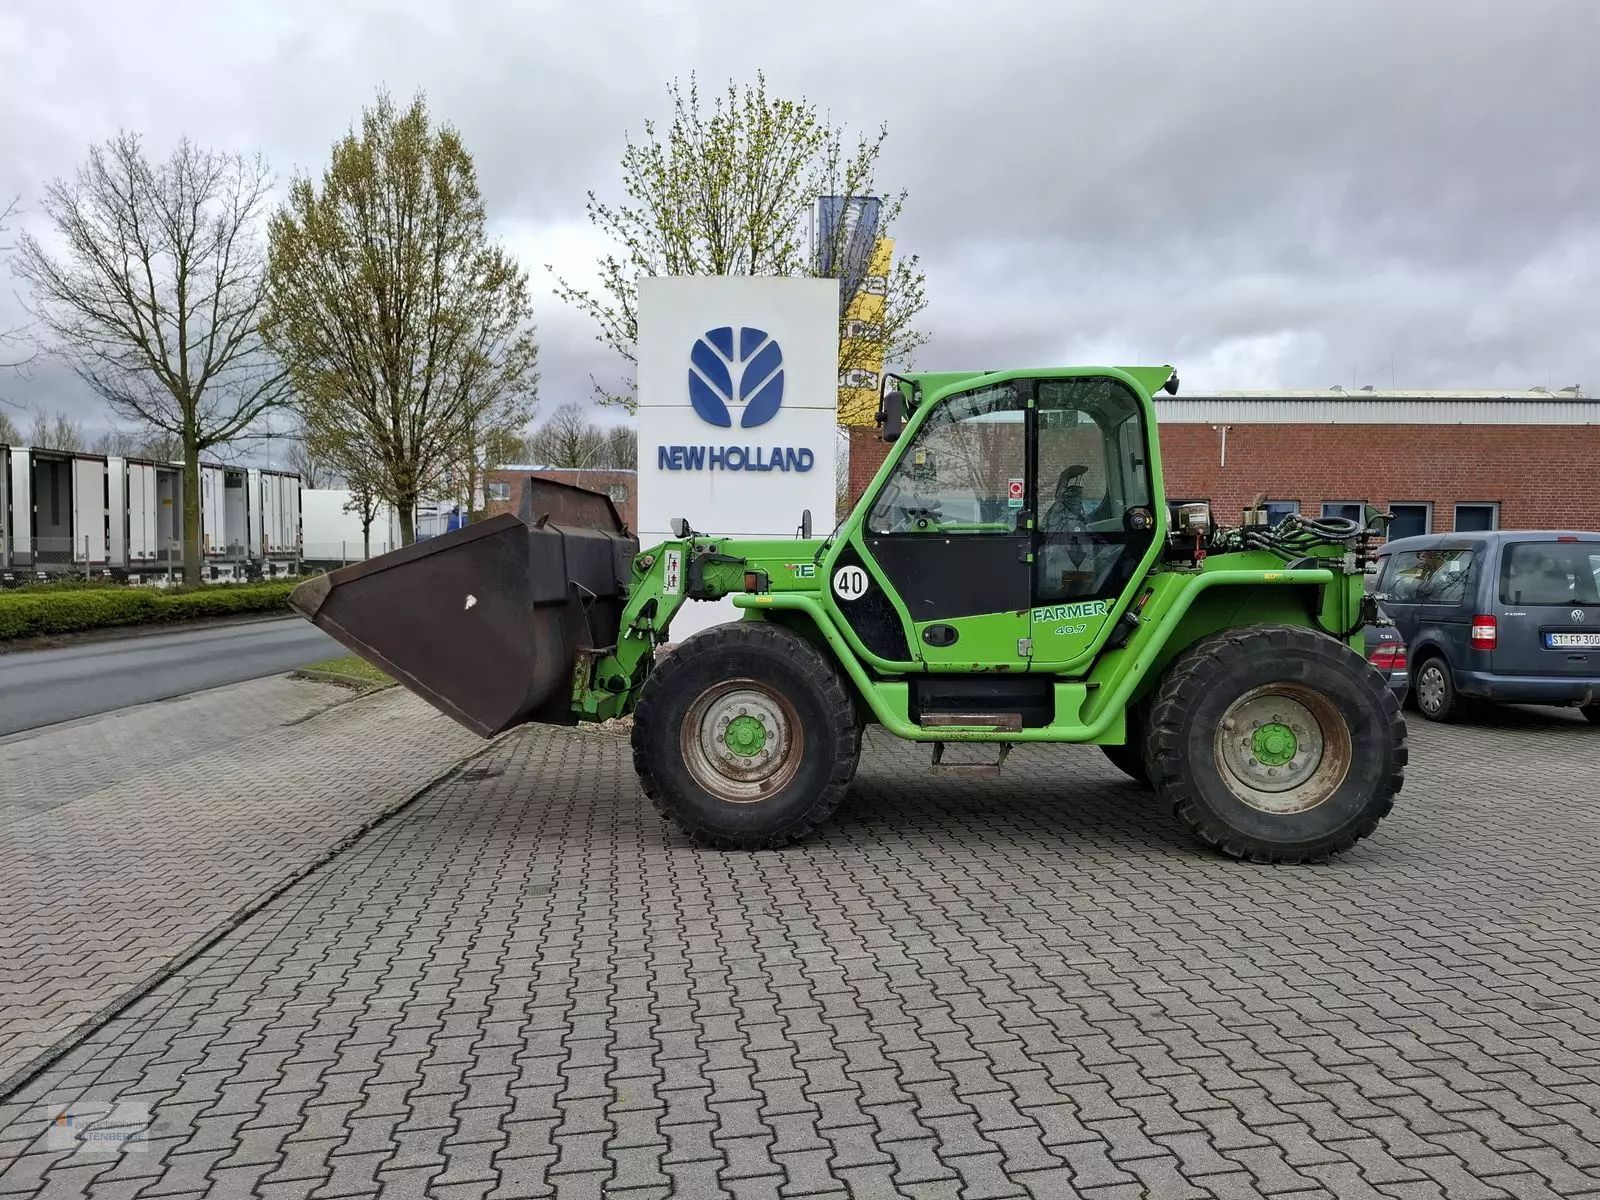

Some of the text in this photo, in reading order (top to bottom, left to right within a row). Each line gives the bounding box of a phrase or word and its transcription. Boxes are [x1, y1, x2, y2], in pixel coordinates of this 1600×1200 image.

[658, 446, 815, 472] NEW HOLLAND
[839, 571, 862, 595] 40
[1032, 602, 1106, 623] FARMER
[1055, 623, 1087, 635] 40.7
[1552, 635, 1564, 645] ST
[1570, 635, 1581, 645] FP
